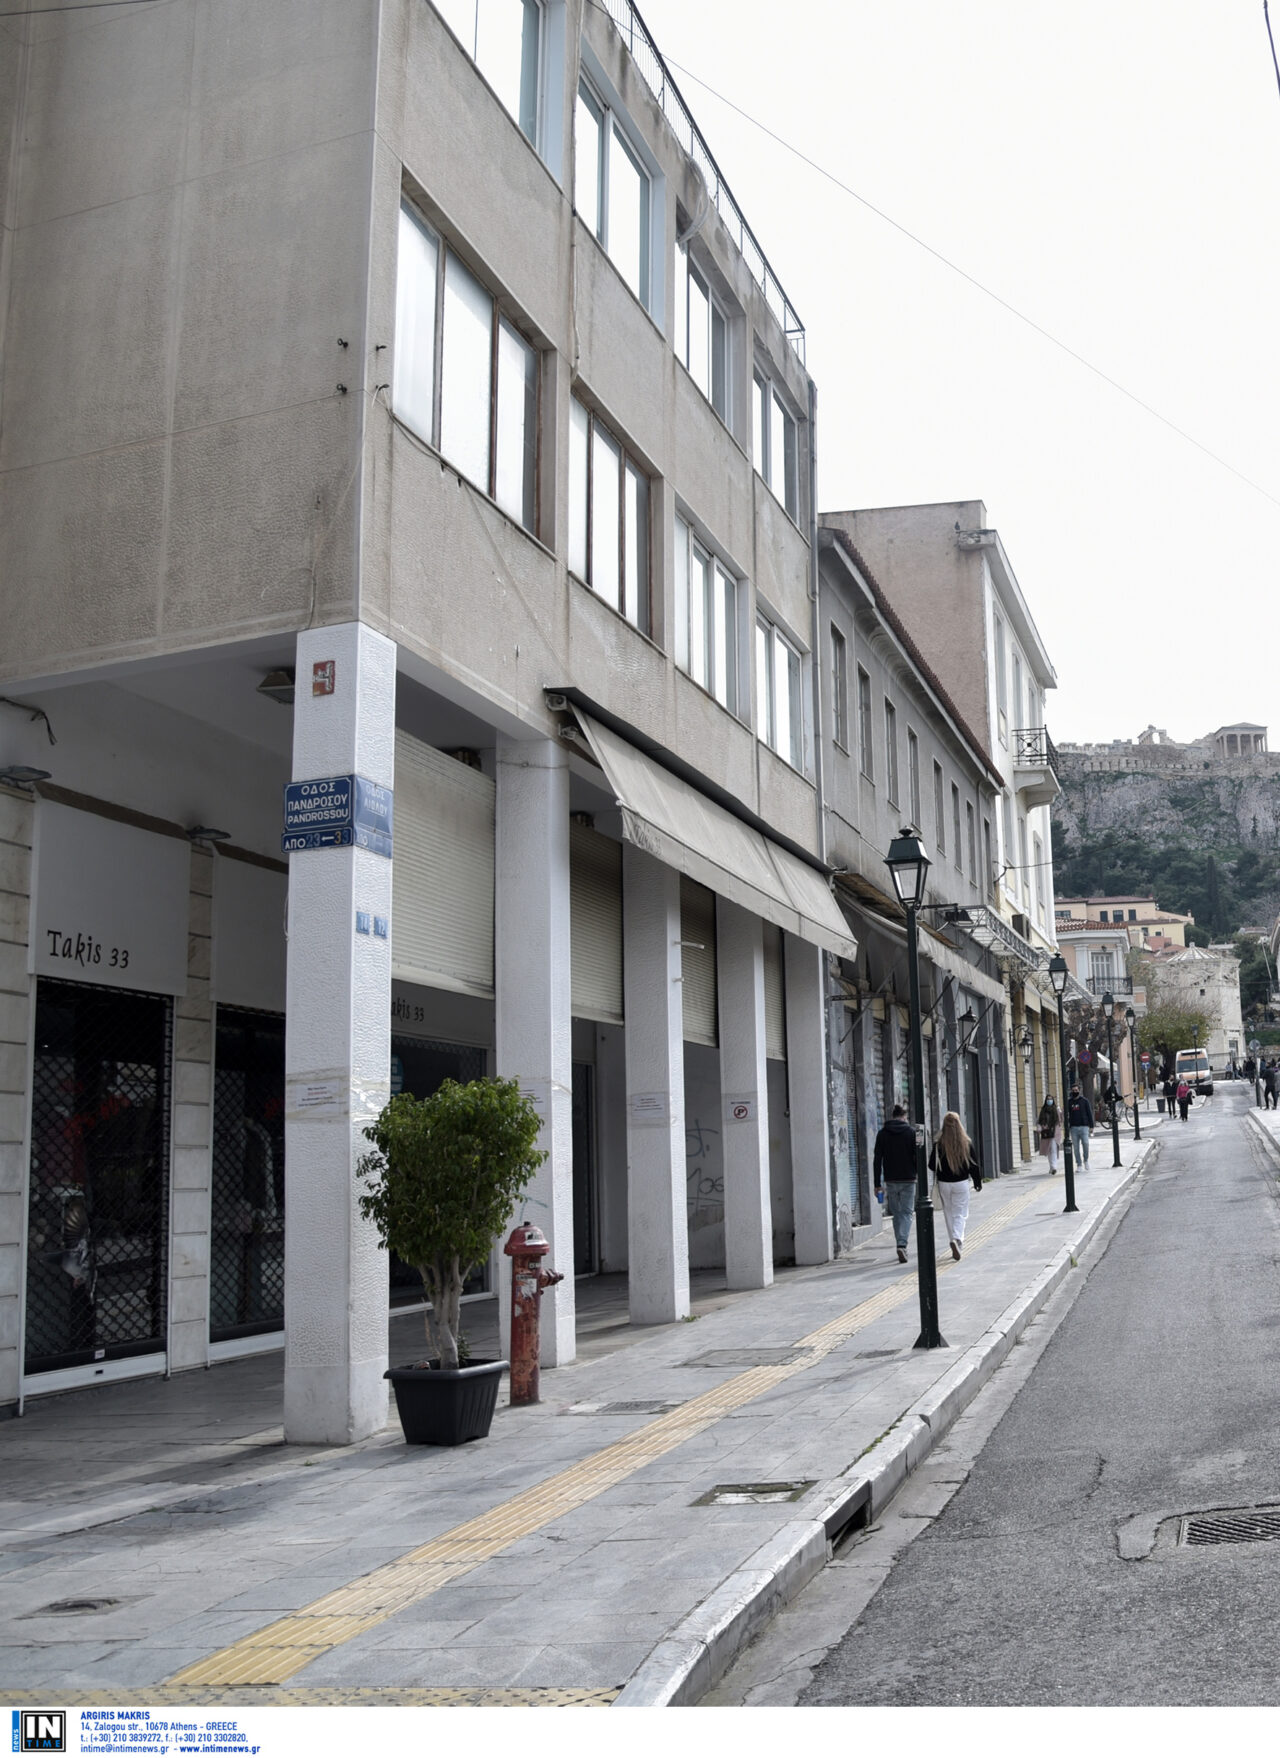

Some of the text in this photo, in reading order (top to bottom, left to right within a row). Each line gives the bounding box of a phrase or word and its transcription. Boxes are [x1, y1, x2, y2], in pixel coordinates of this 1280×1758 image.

[301, 782, 336, 796] ΟΔΟΣ
[288, 794, 348, 811] ΠΑΝΔΡΟΣΟΥ
[287, 808, 349, 825] PANDROSSOU
[284, 838, 306, 850] ΑΠΟ
[47, 929, 129, 969] Takis 33
[391, 997, 410, 1021] akis
